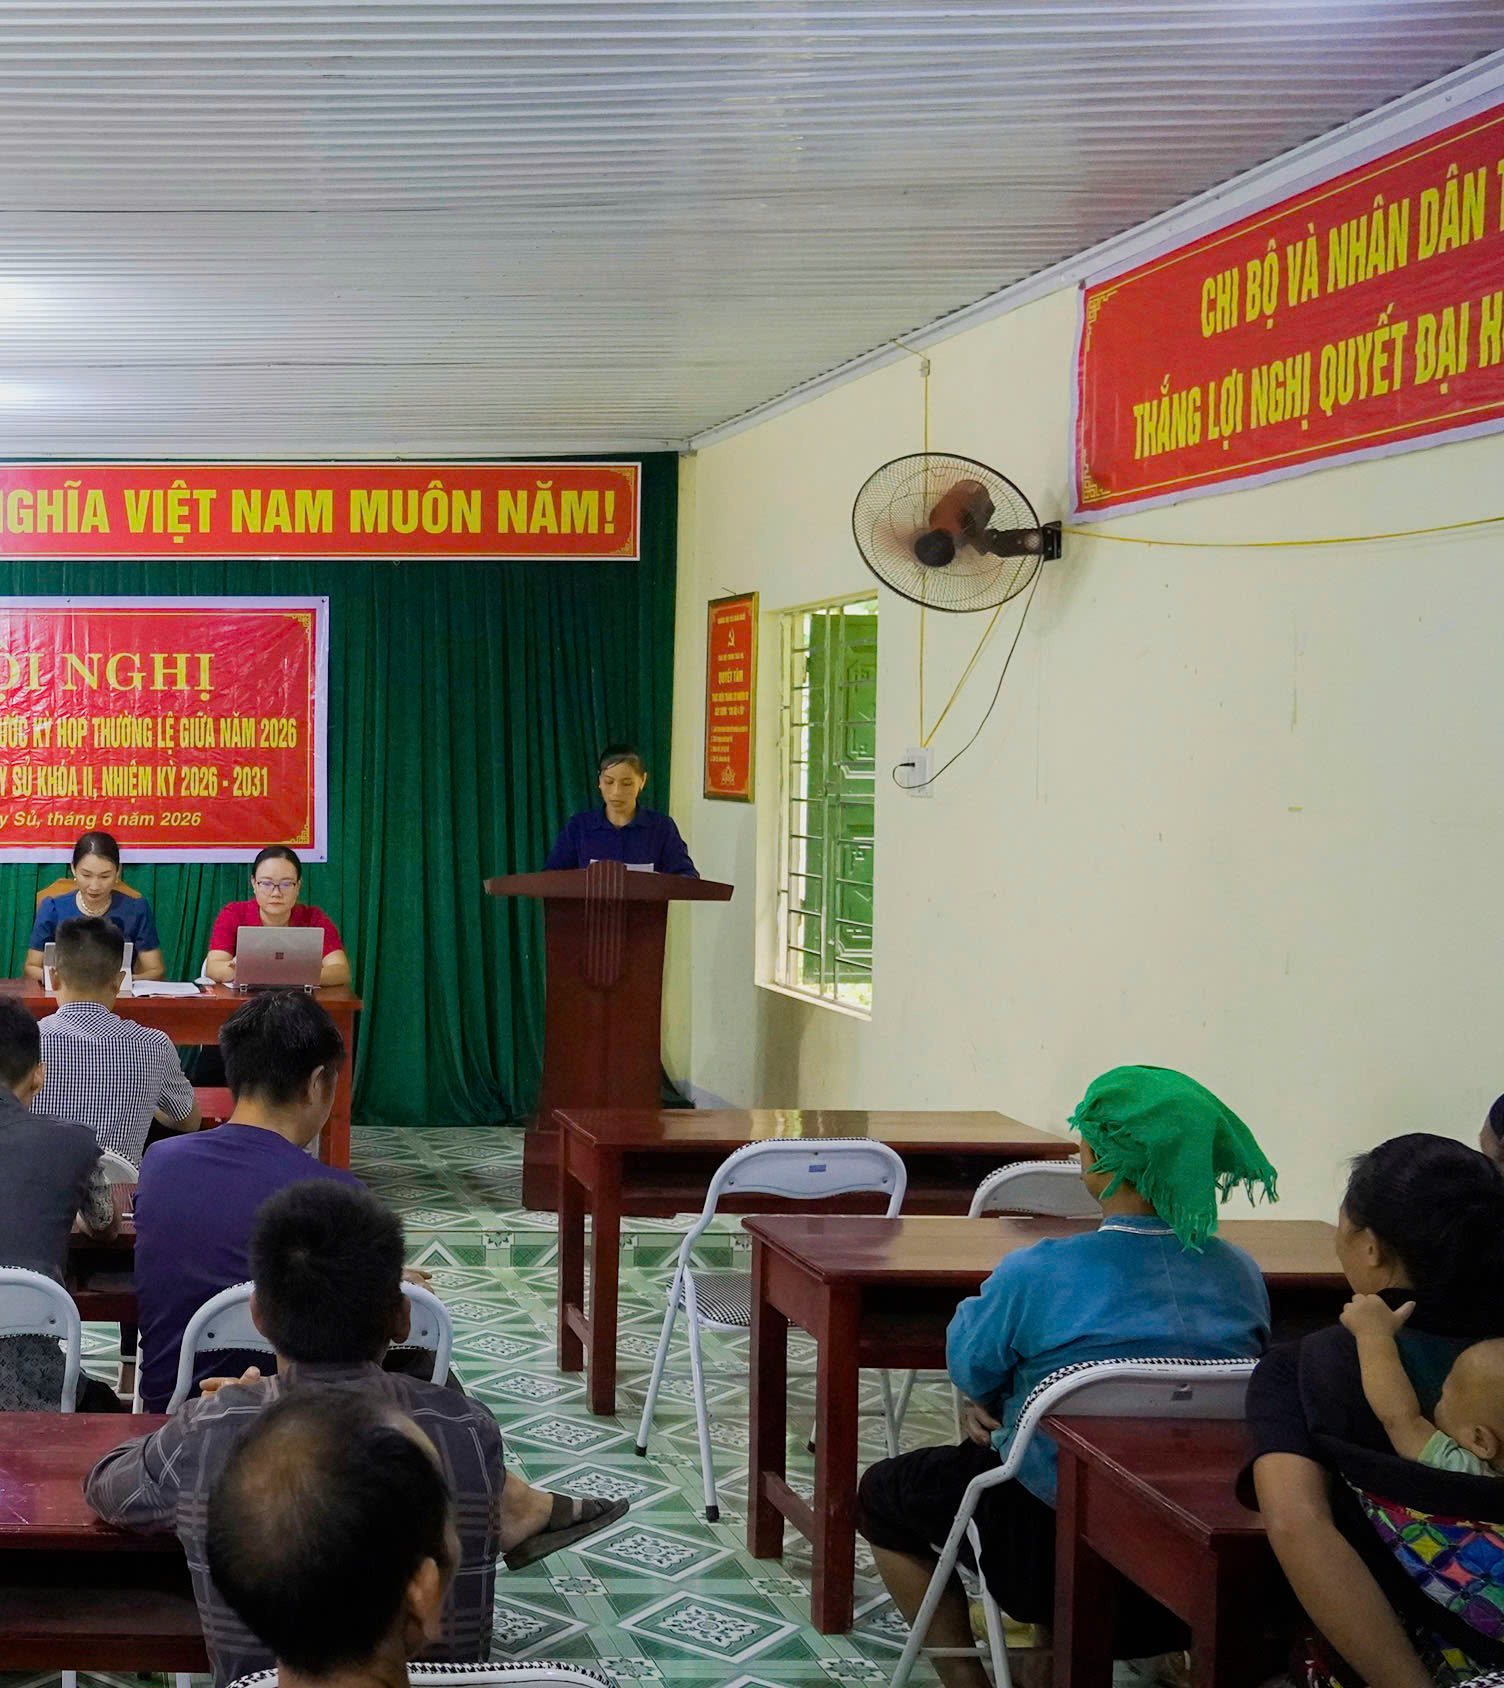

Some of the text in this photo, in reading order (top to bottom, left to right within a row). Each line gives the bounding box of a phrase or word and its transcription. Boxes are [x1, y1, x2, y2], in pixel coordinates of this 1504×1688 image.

[1200, 266, 1239, 338] CHI
[1244, 238, 1279, 330] BỘ
[1286, 223, 1319, 308] VÀ
[1327, 194, 1410, 294] NHÂN
[1417, 163, 1488, 262] DÂN
[1133, 290, 1504, 460] THẮNG LỢI NGHỊ QUYẾT ĐẠI H
[123, 479, 216, 544] VIỆT
[232, 490, 333, 534] NAM
[350, 480, 482, 535] MUÔN
[499, 480, 615, 534] NĂM!
[63, 652, 215, 702] NGHỊ
[33, 711, 52, 748] KỲ
[56, 717, 88, 755] HỌP
[92, 710, 153, 748] THƯỜNG
[158, 711, 175, 755] LỆ
[180, 711, 216, 748] GIỮA
[220, 712, 256, 748] NĂM
[260, 718, 297, 748] 2026
[12, 756, 32, 797] SỦ
[37, 760, 78, 797] KHÓA
[82, 767, 97, 800] II,
[102, 760, 152, 803] NHIỆM
[157, 761, 176, 797] KỲ
[181, 767, 218, 797] 2026
[233, 767, 268, 797] 2031
[14, 810, 40, 828] Sủ,
[47, 811, 97, 830] tháng
[102, 812, 112, 826] 6
[118, 811, 155, 826] năm
[160, 812, 201, 826] 2026
